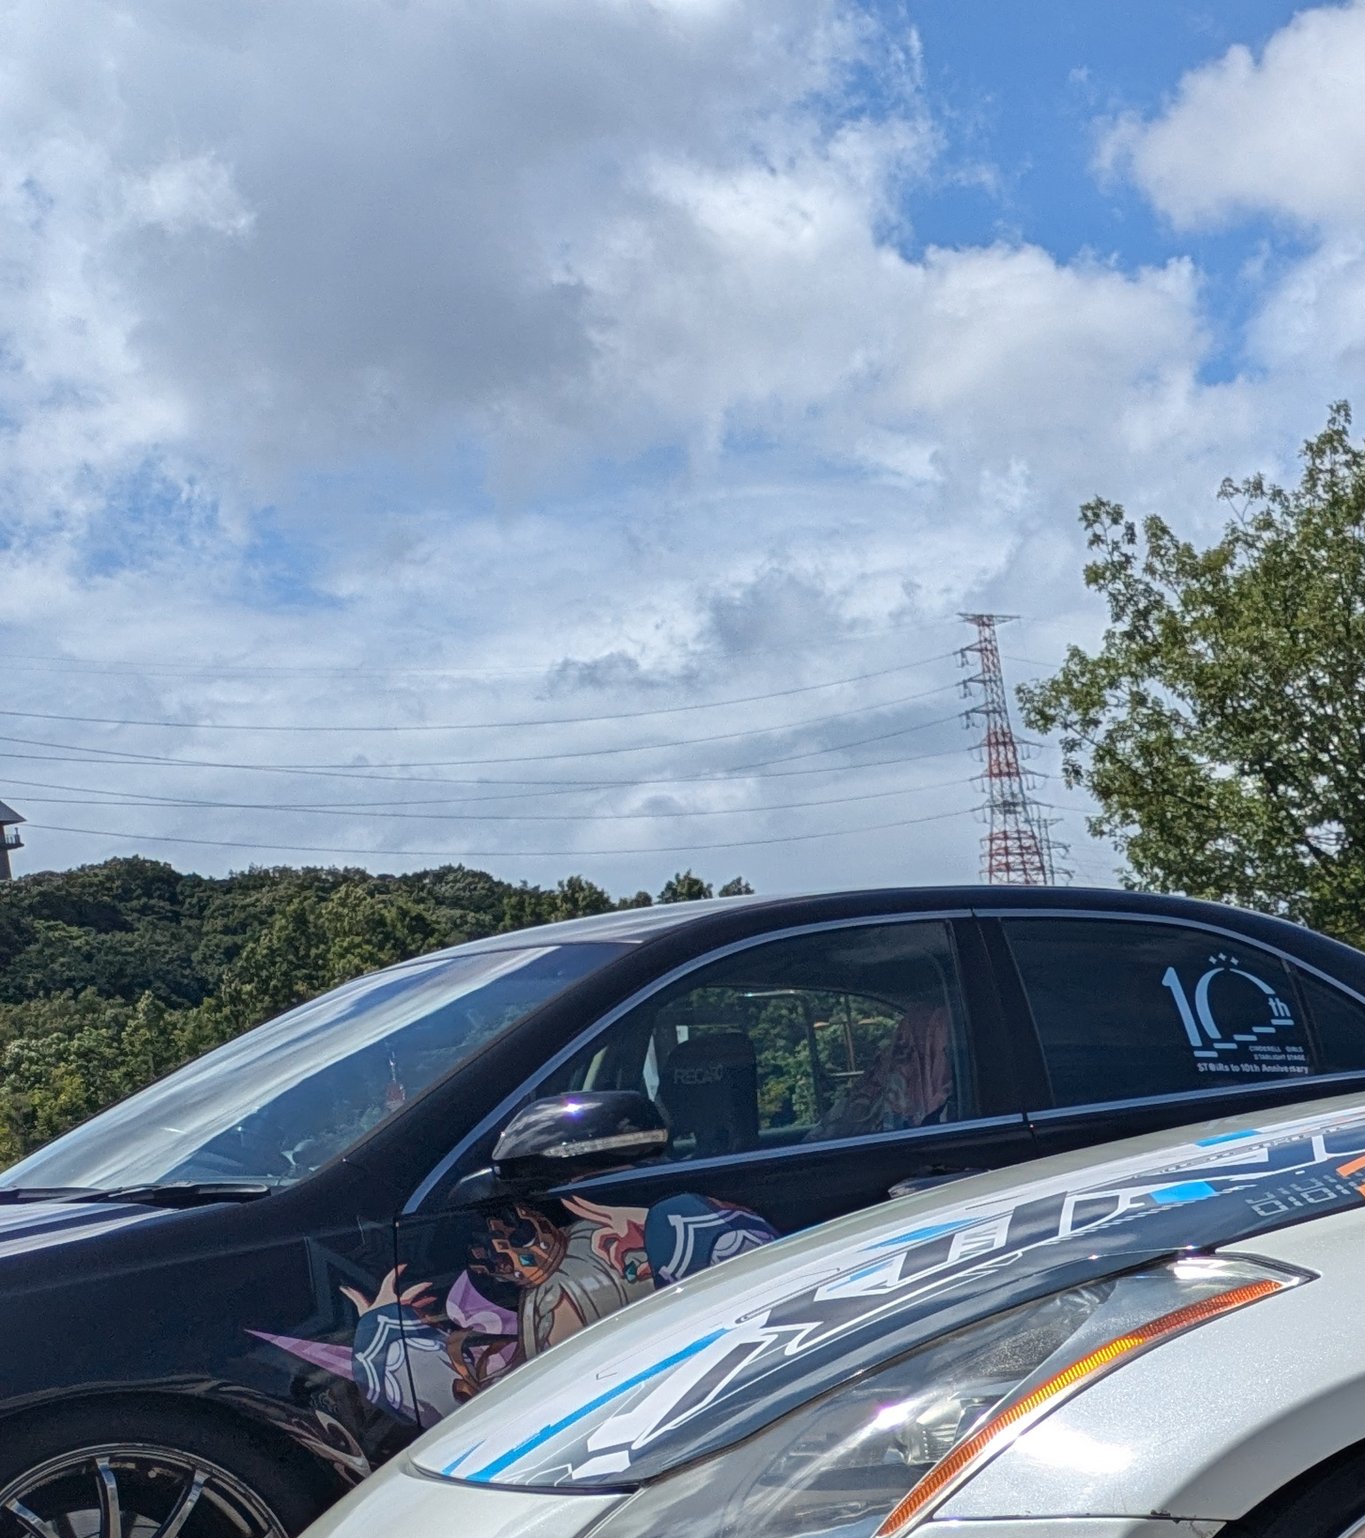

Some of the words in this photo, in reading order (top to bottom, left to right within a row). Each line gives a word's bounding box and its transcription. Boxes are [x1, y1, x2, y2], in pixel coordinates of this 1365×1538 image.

[1230, 1064, 1240, 1073] to
[1240, 1064, 1261, 1073] 10th
[1261, 1064, 1309, 1075] Anniversary
